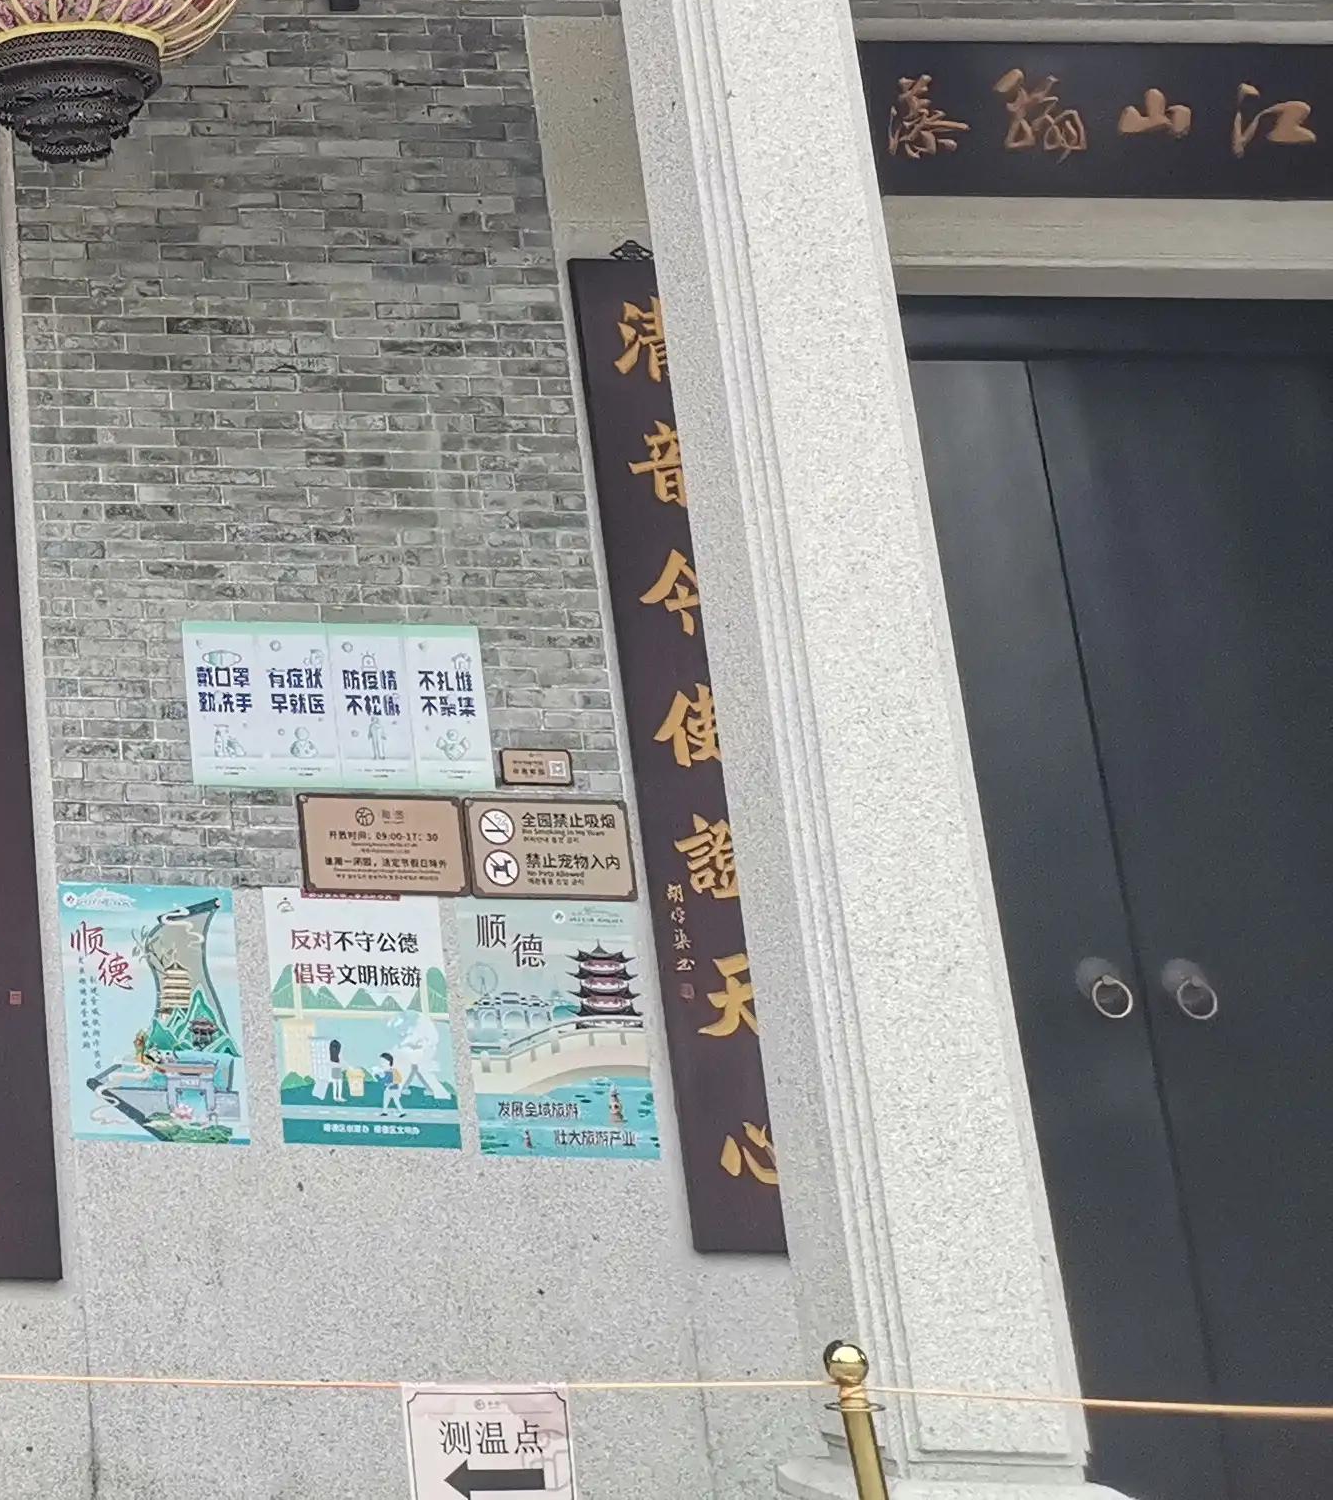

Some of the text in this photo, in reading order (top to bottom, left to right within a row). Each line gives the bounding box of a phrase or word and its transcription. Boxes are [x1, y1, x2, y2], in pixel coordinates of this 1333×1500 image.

[195, 666, 250, 687] 戴口罩
[266, 667, 323, 688] 有症状
[342, 669, 398, 690] 防疫情
[418, 670, 473, 691] 不扎堆
[198, 691, 252, 713] 勤洗手
[271, 693, 325, 714] 早就医
[345, 694, 401, 716] 不松懈
[420, 695, 476, 717] 不聚集
[522, 812, 616, 829] 全园禁止吸烟
[526, 853, 621, 870] 禁止宠物入内
[291, 928, 420, 954] 反对不守公德
[477, 913, 546, 969] 顺德
[70, 920, 134, 991] 顺德
[293, 962, 422, 989] 倡导文明旅游
[498, 1101, 579, 1119] 发展全域旅游
[554, 1129, 637, 1148] 壮大旅游产业
[438, 1419, 545, 1456] 测温点
